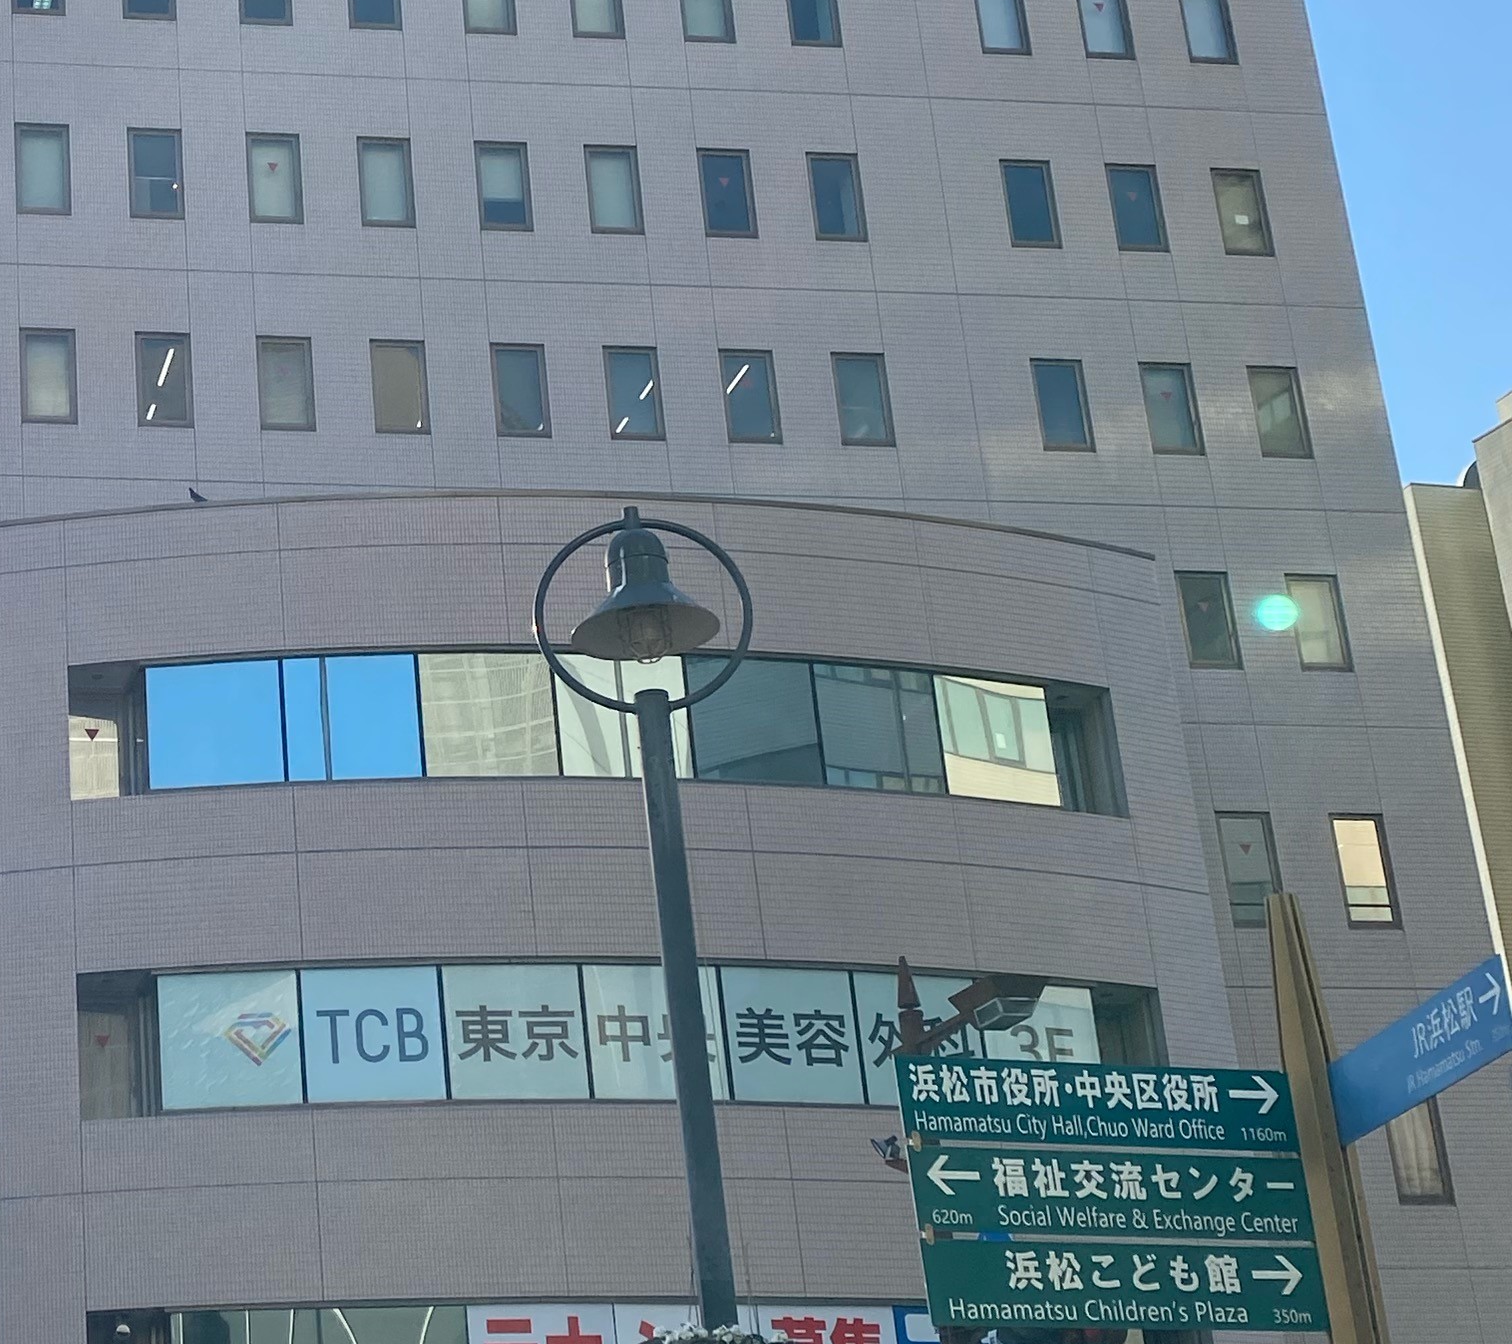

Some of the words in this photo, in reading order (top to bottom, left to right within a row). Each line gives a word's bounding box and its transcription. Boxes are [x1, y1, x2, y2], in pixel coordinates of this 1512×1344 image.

[316, 1007, 430, 1064] TCB
[1412, 987, 1478, 1058] JR浜松駅
[909, 1063, 1219, 1112] 浜松市役所・中央区役所
[915, 1110, 1011, 1134] Hamamatsu
[1016, 1113, 1047, 1141] City
[1134, 1117, 1175, 1140] Ward
[1179, 1118, 1225, 1141] Office
[1240, 1126, 1287, 1142] 1160m
[991, 1157, 1295, 1202] 福祉交流センター
[932, 1209, 973, 1225] 620m
[998, 1204, 1052, 1228] Social
[1055, 1206, 1126, 1229] Welfare
[1132, 1211, 1148, 1229] &
[1153, 1209, 1236, 1237] Exchange
[1241, 1212, 1298, 1234] Center
[1005, 1250, 1241, 1294] 浜松こども館
[949, 1298, 1077, 1322] Hamamatsu
[1085, 1299, 1188, 1324] Children's
[1197, 1303, 1248, 1324] Plaza
[1273, 1308, 1312, 1324] 350m
